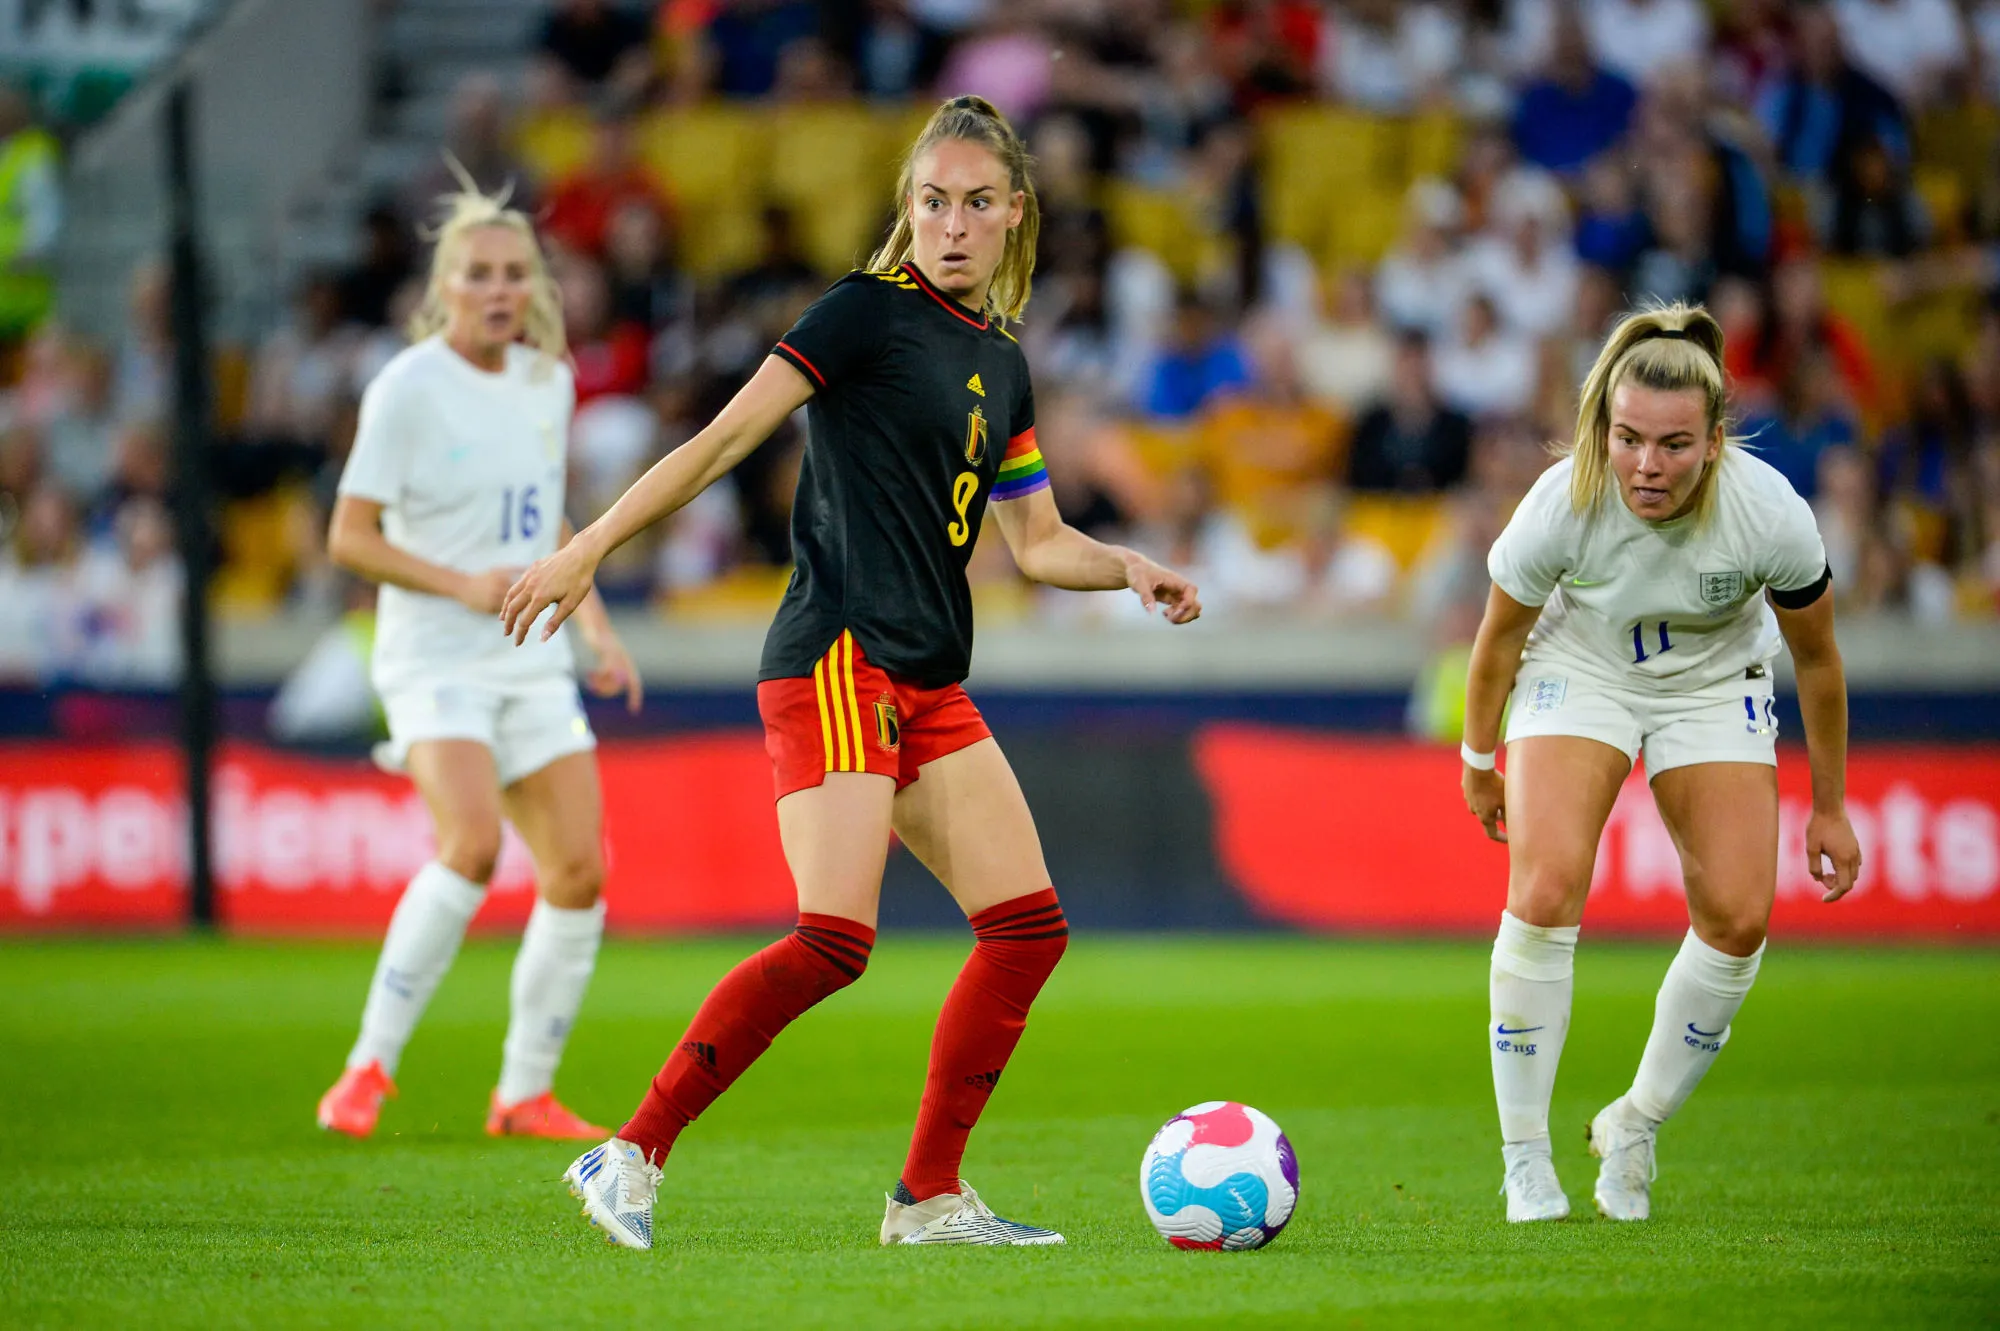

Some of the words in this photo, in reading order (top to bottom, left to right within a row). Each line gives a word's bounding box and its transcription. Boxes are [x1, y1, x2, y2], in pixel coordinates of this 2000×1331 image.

[500, 485, 542, 542] 16
[947, 471, 979, 547] 9
[1628, 621, 1676, 664] 11
[1496, 1040, 1537, 1056] Eng
